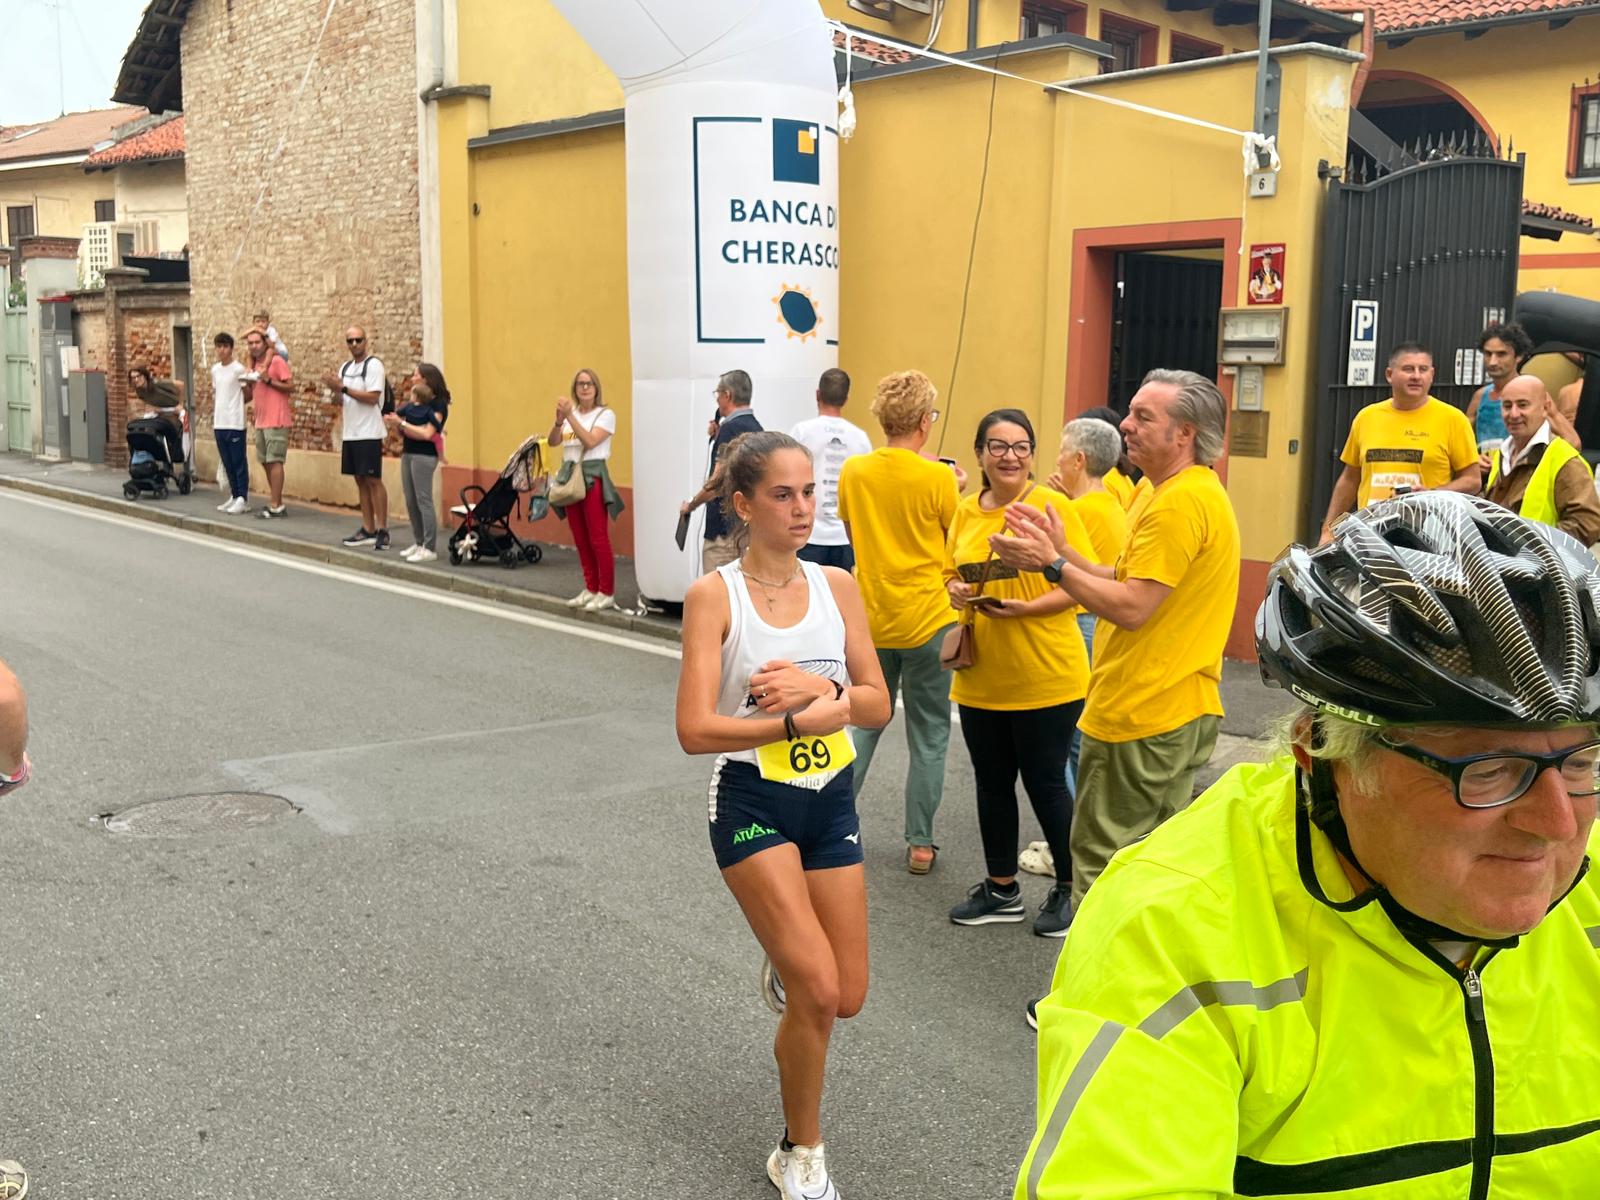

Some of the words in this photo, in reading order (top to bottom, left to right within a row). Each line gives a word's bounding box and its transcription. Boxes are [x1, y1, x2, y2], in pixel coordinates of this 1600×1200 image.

[1259, 177, 1266, 190] 6
[730, 198, 823, 226] BANCA
[721, 239, 839, 270] CHERASCO
[1356, 307, 1373, 340] P
[790, 738, 831, 774] 69
